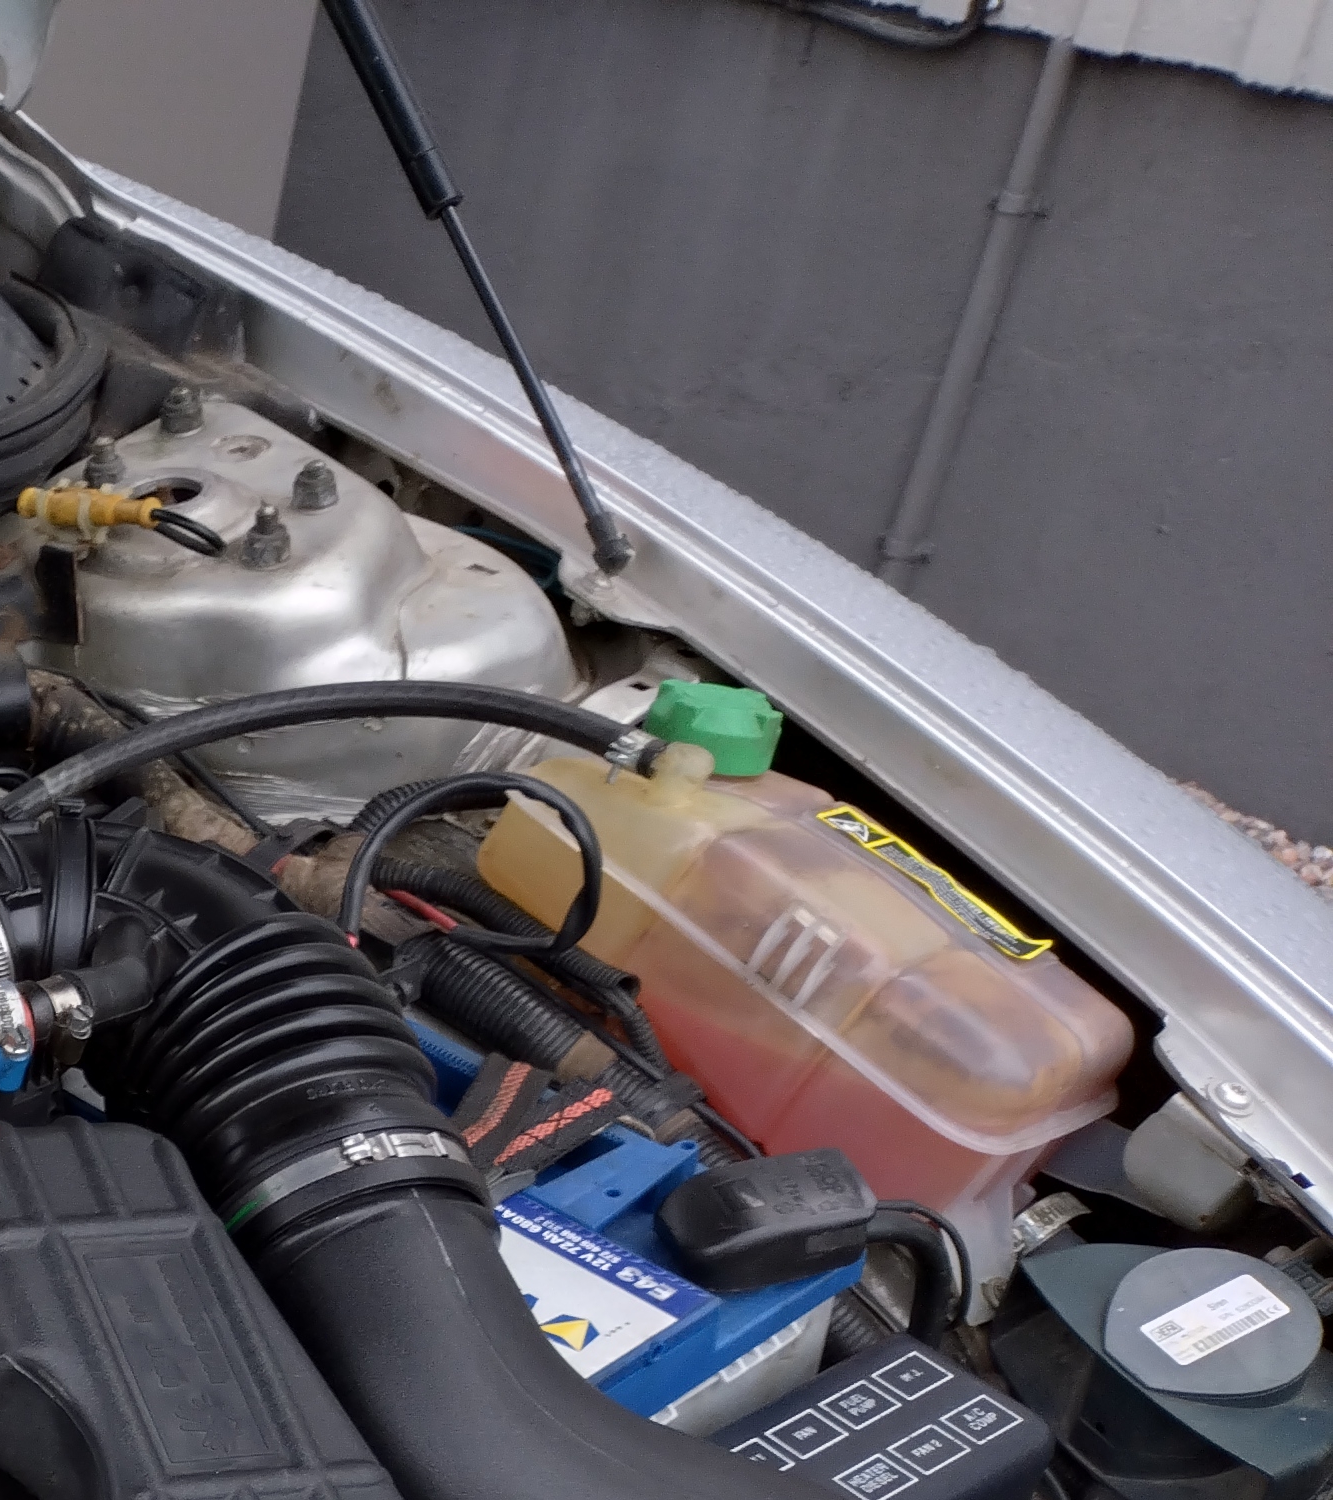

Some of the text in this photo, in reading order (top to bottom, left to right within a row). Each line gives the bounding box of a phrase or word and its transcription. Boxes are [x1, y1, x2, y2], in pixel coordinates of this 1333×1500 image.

[539, 1229, 583, 1255] 72Ah
[577, 1250, 614, 1271] 12V
[613, 1264, 680, 1301] E43
[836, 1391, 868, 1409] FUEL
[961, 1406, 986, 1422] A/C
[967, 1410, 1001, 1432] COMP
[790, 1424, 820, 1441] FAN
